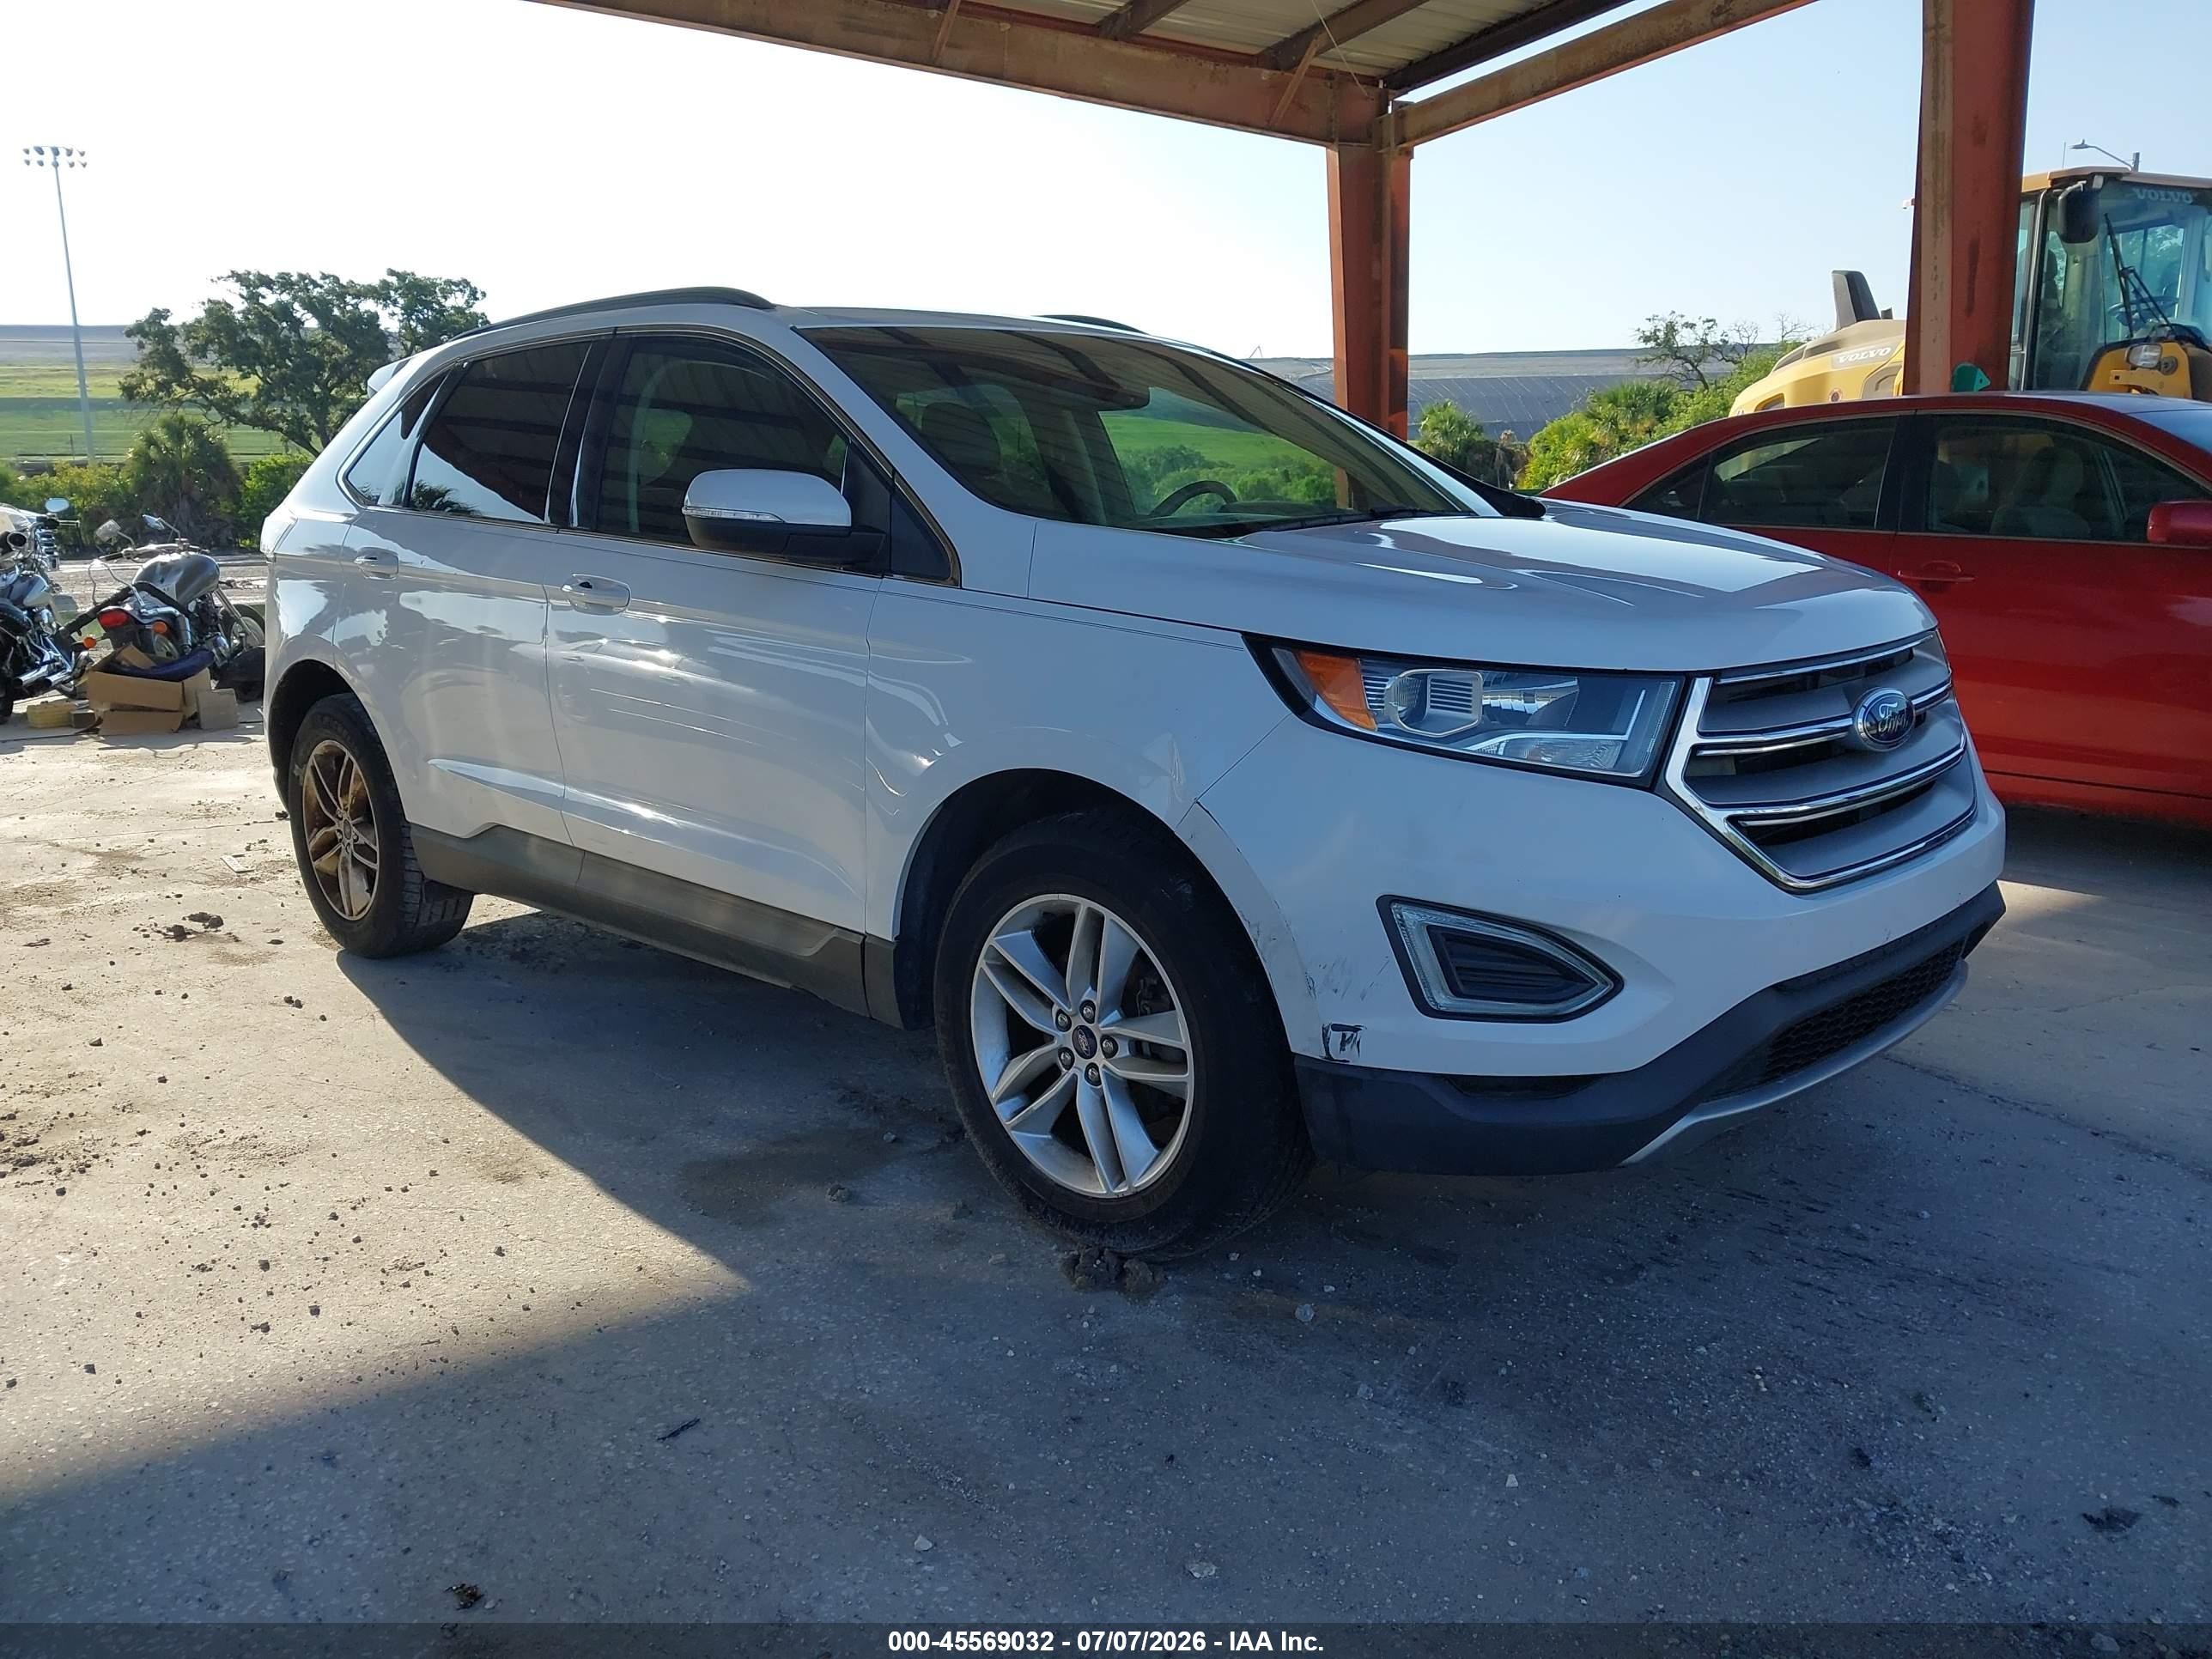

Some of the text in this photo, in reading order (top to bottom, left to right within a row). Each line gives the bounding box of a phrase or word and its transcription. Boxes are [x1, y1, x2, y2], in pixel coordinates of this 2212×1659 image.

[2131, 188, 2193, 204] VOLVO
[1838, 347, 1892, 362] VOLVO
[1878, 702, 1910, 733] Ford
